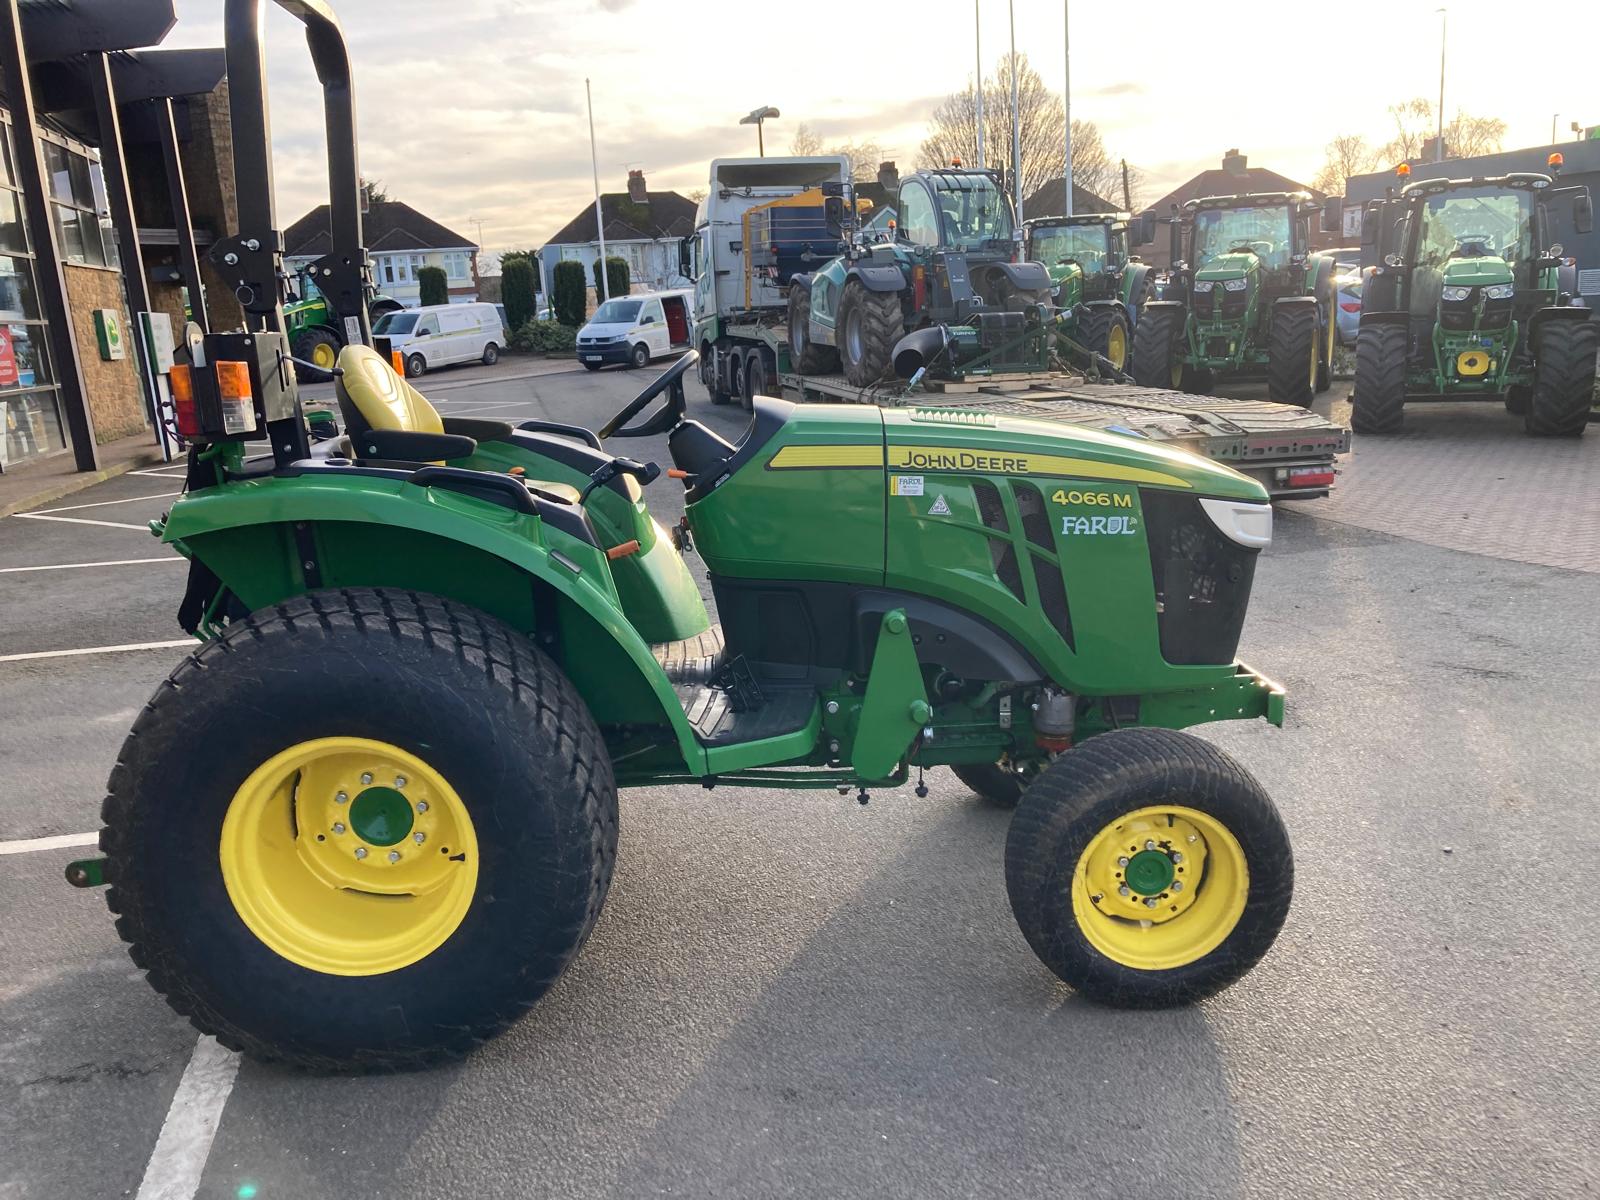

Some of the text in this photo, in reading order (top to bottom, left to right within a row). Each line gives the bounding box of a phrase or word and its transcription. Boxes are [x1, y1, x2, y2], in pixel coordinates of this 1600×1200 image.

[902, 451, 1028, 472] JOHN DEERE
[1051, 489, 1132, 508] 4066 M
[1061, 516, 1136, 535] FAROL
